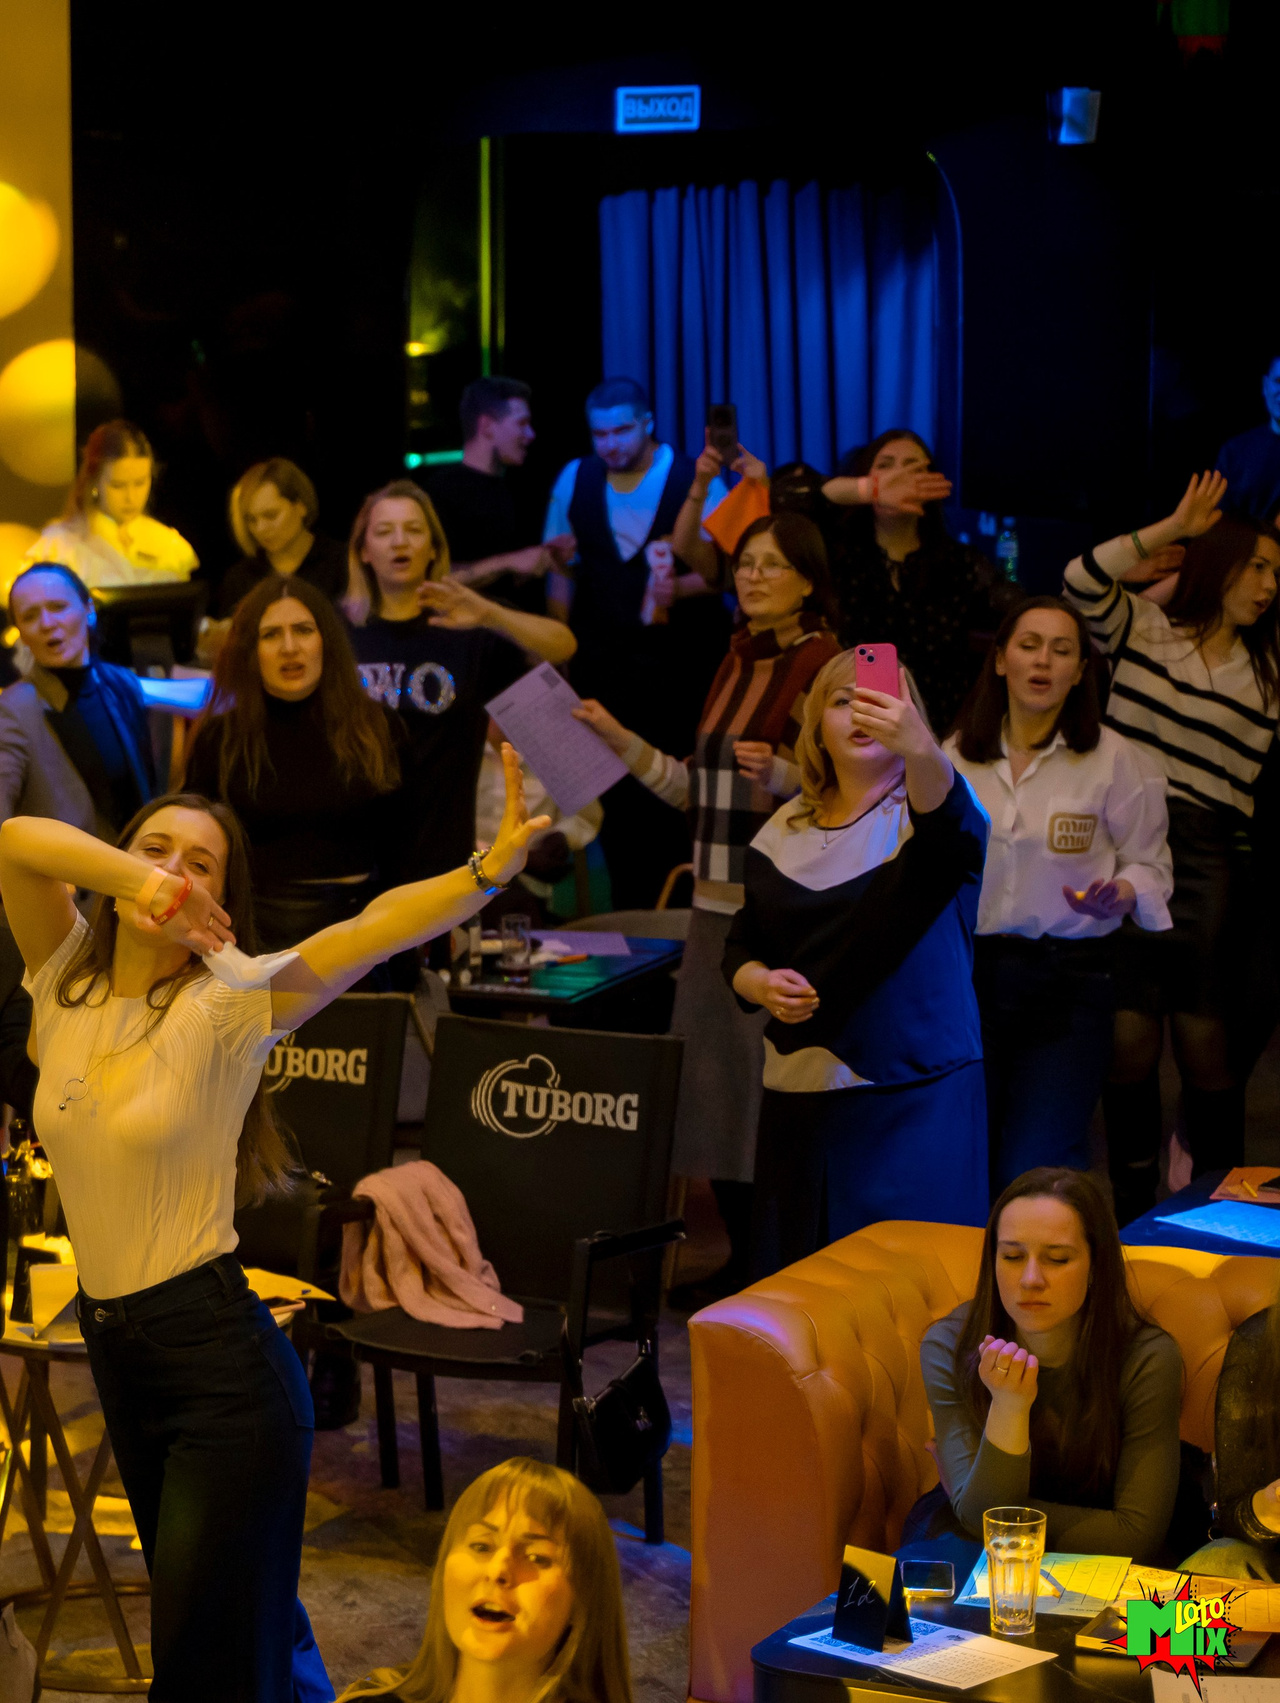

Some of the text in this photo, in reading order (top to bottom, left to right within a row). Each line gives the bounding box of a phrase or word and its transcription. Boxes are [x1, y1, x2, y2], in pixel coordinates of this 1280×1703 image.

[625, 96, 693, 120] ВЫХОД
[264, 1045, 368, 1086] UBORG
[500, 1078, 640, 1132] TUBORG
